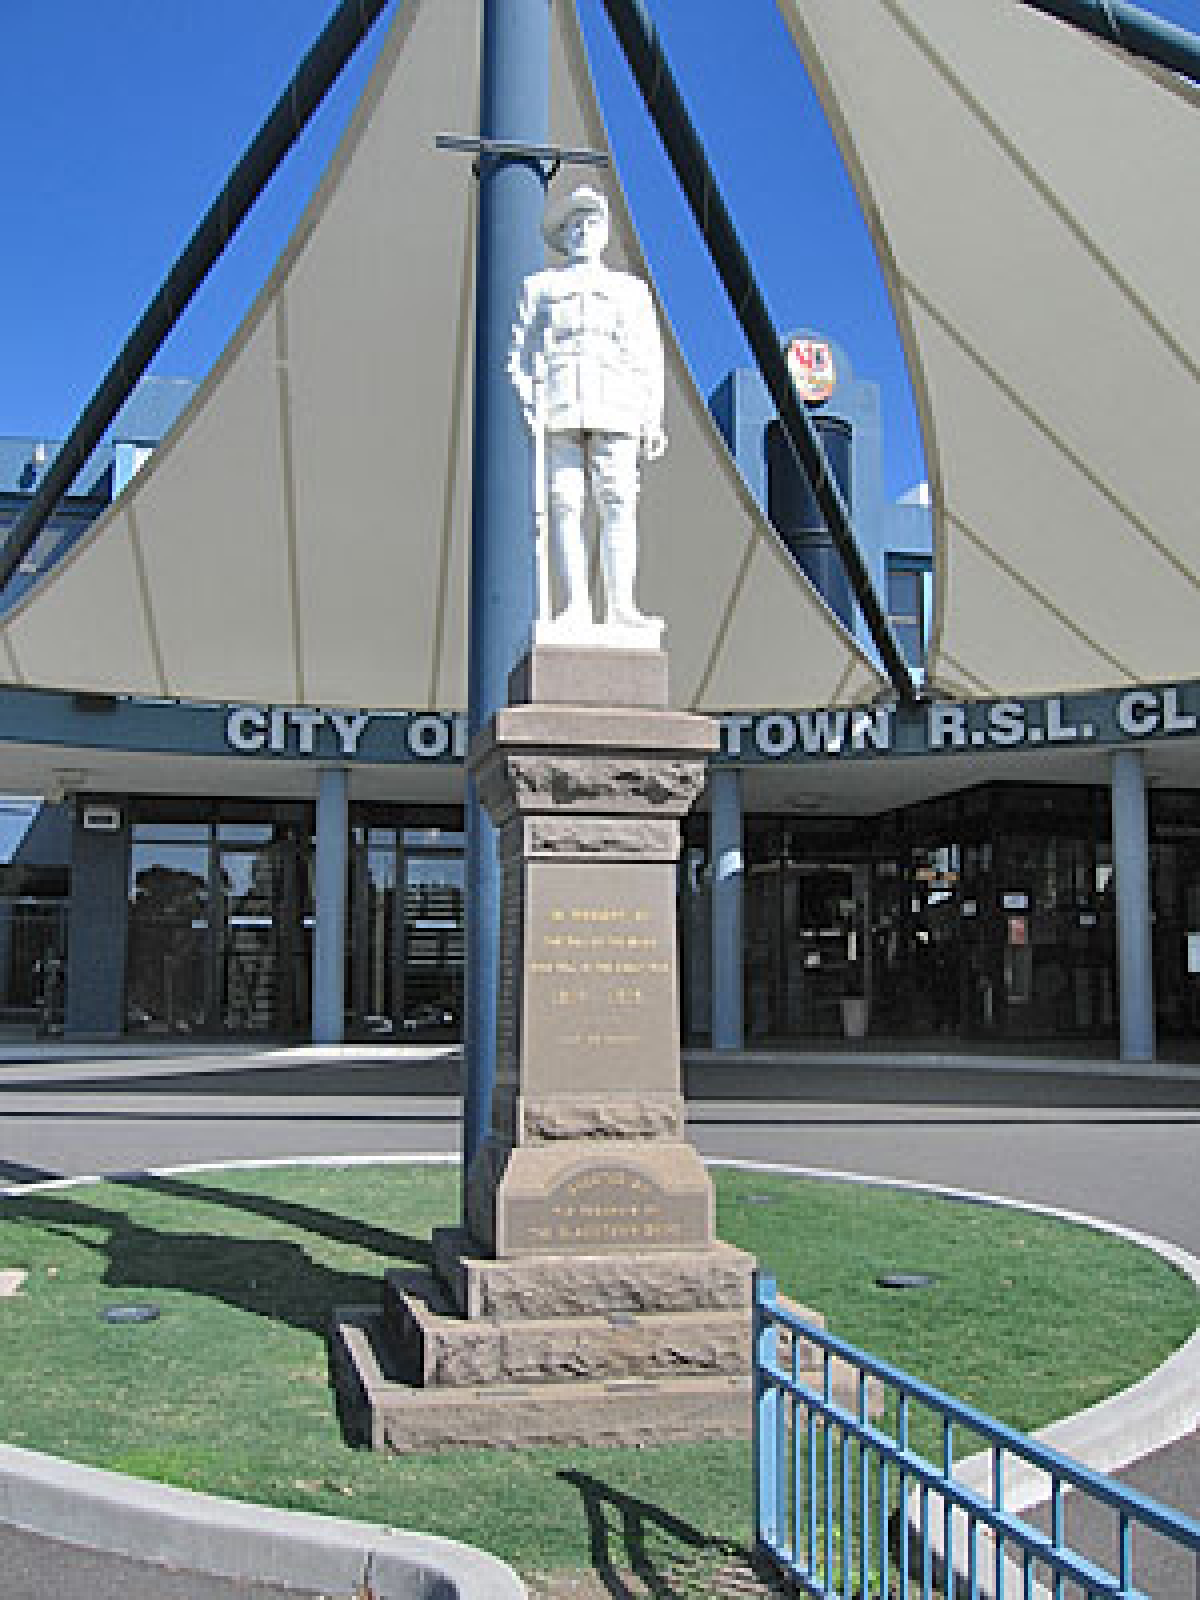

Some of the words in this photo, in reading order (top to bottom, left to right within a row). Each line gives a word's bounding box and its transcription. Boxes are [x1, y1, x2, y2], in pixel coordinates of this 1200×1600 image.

[226, 708, 369, 754] CITY
[929, 700, 1094, 746] R.S.L.
[1119, 688, 1197, 734] CL
